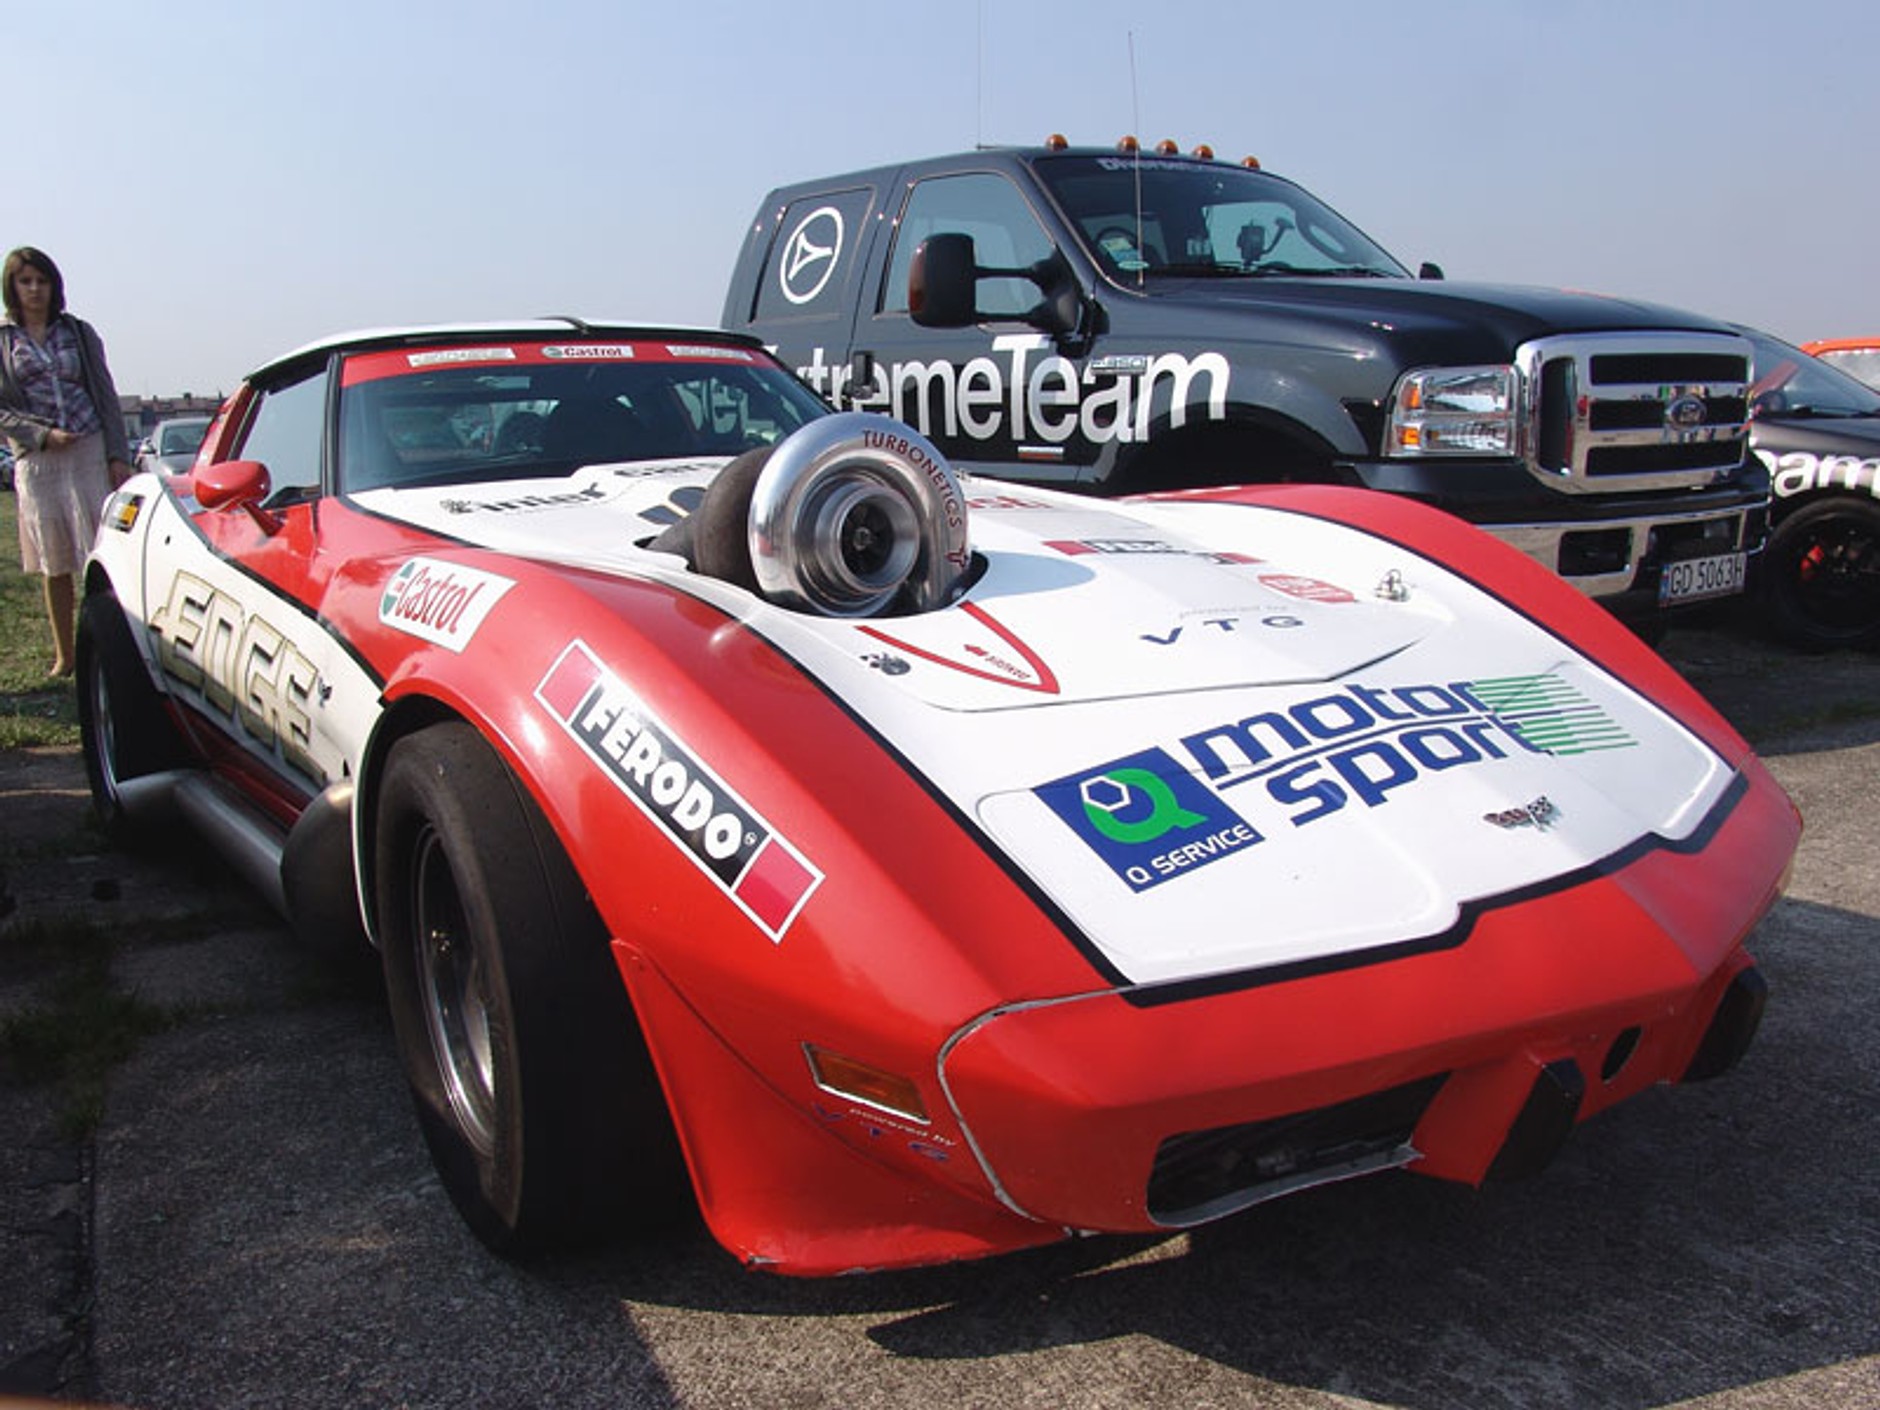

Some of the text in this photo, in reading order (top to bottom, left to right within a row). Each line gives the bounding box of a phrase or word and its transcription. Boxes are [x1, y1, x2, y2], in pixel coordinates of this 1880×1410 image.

[564, 346, 622, 359] Castrol
[862, 429, 963, 528] TURBONETICS
[394, 566, 487, 634] Castrol
[1671, 556, 1743, 595] GD 5063H
[582, 682, 744, 860] FERODO
[1179, 682, 1492, 781] motor
[1266, 716, 1555, 827] sport
[1125, 824, 1257, 888] Q SERVICE
